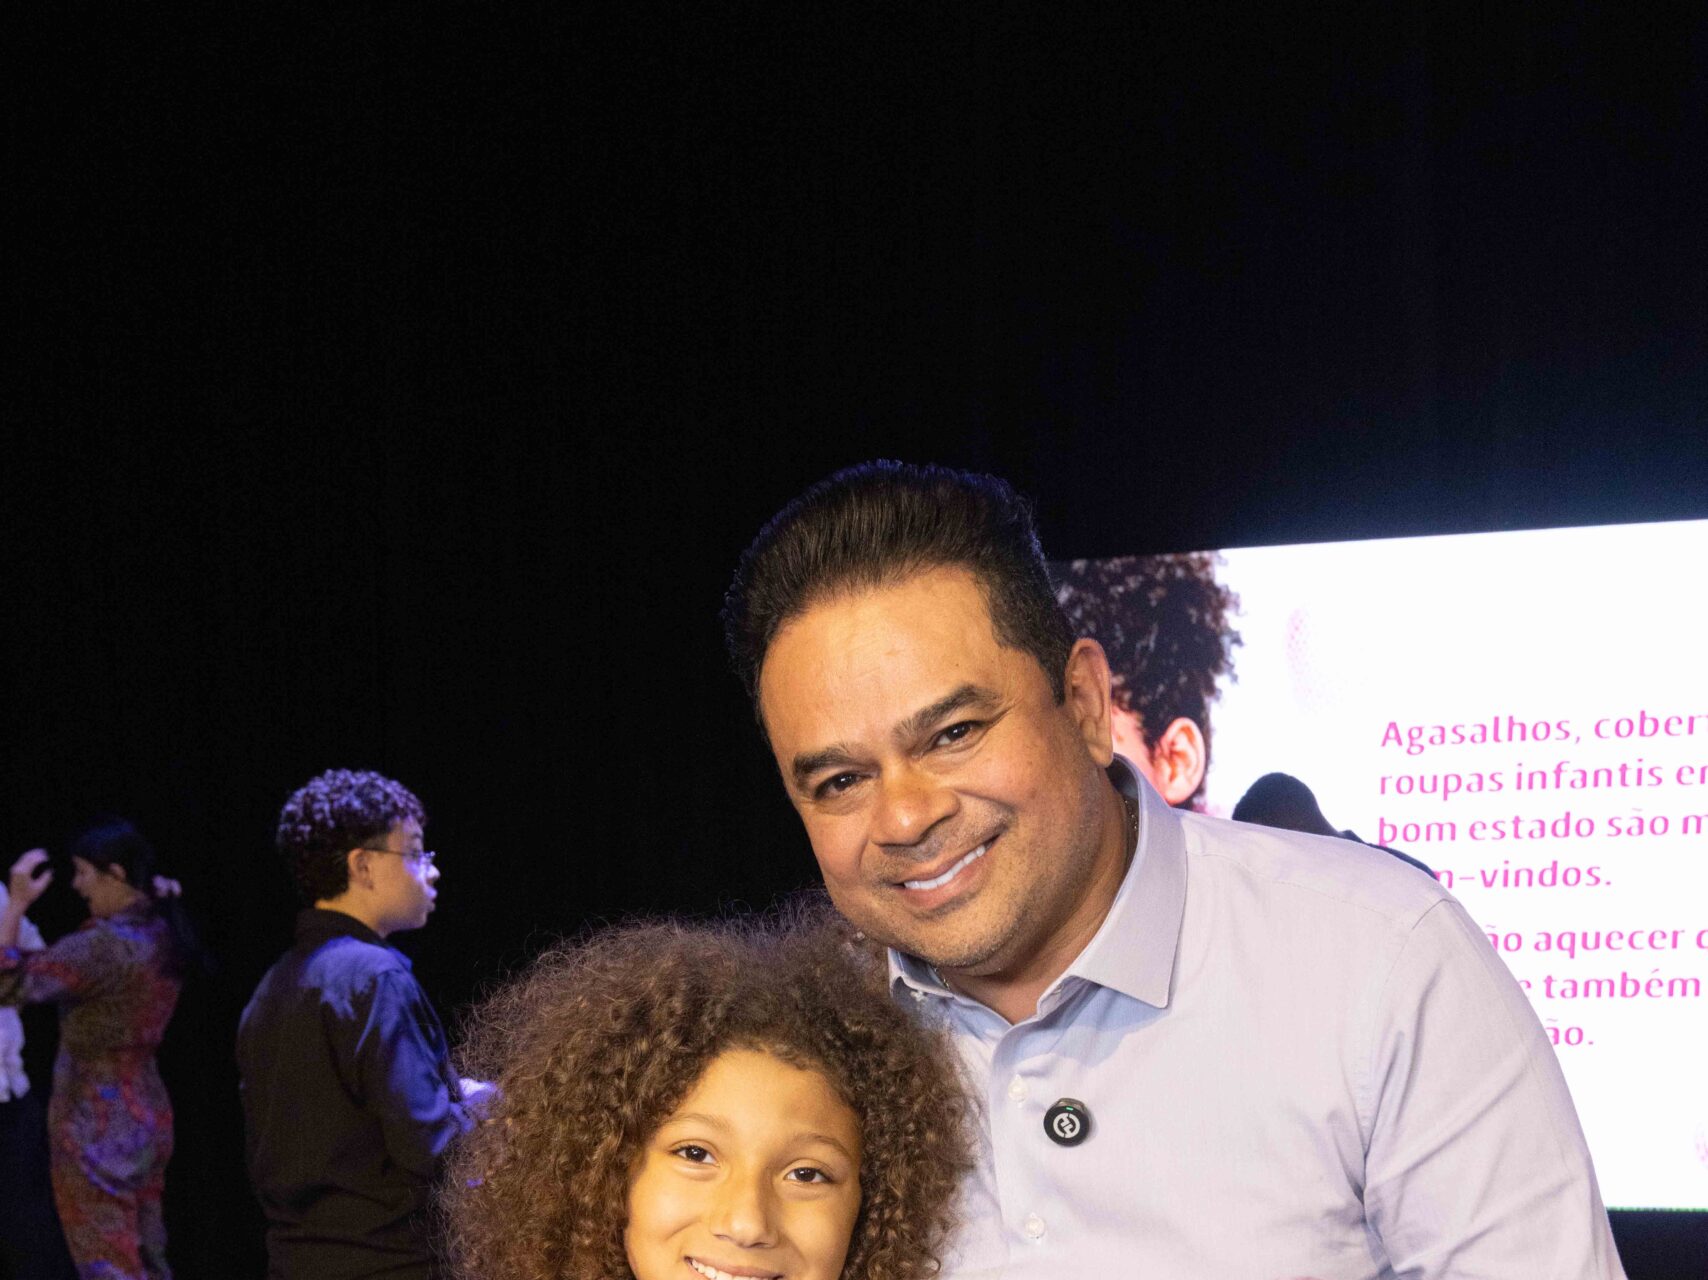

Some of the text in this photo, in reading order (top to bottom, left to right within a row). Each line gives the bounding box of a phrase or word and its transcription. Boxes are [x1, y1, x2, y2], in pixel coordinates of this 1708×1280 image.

[1380, 710, 1708, 757] Agasalhos, cober
[1379, 771, 1504, 801] roupas
[1515, 758, 1664, 791] infantis
[1378, 816, 1457, 844] bom
[1468, 811, 1596, 842] estado
[1606, 806, 1670, 838] são
[1533, 929, 1685, 960] aquecer
[1542, 967, 1702, 999] também
